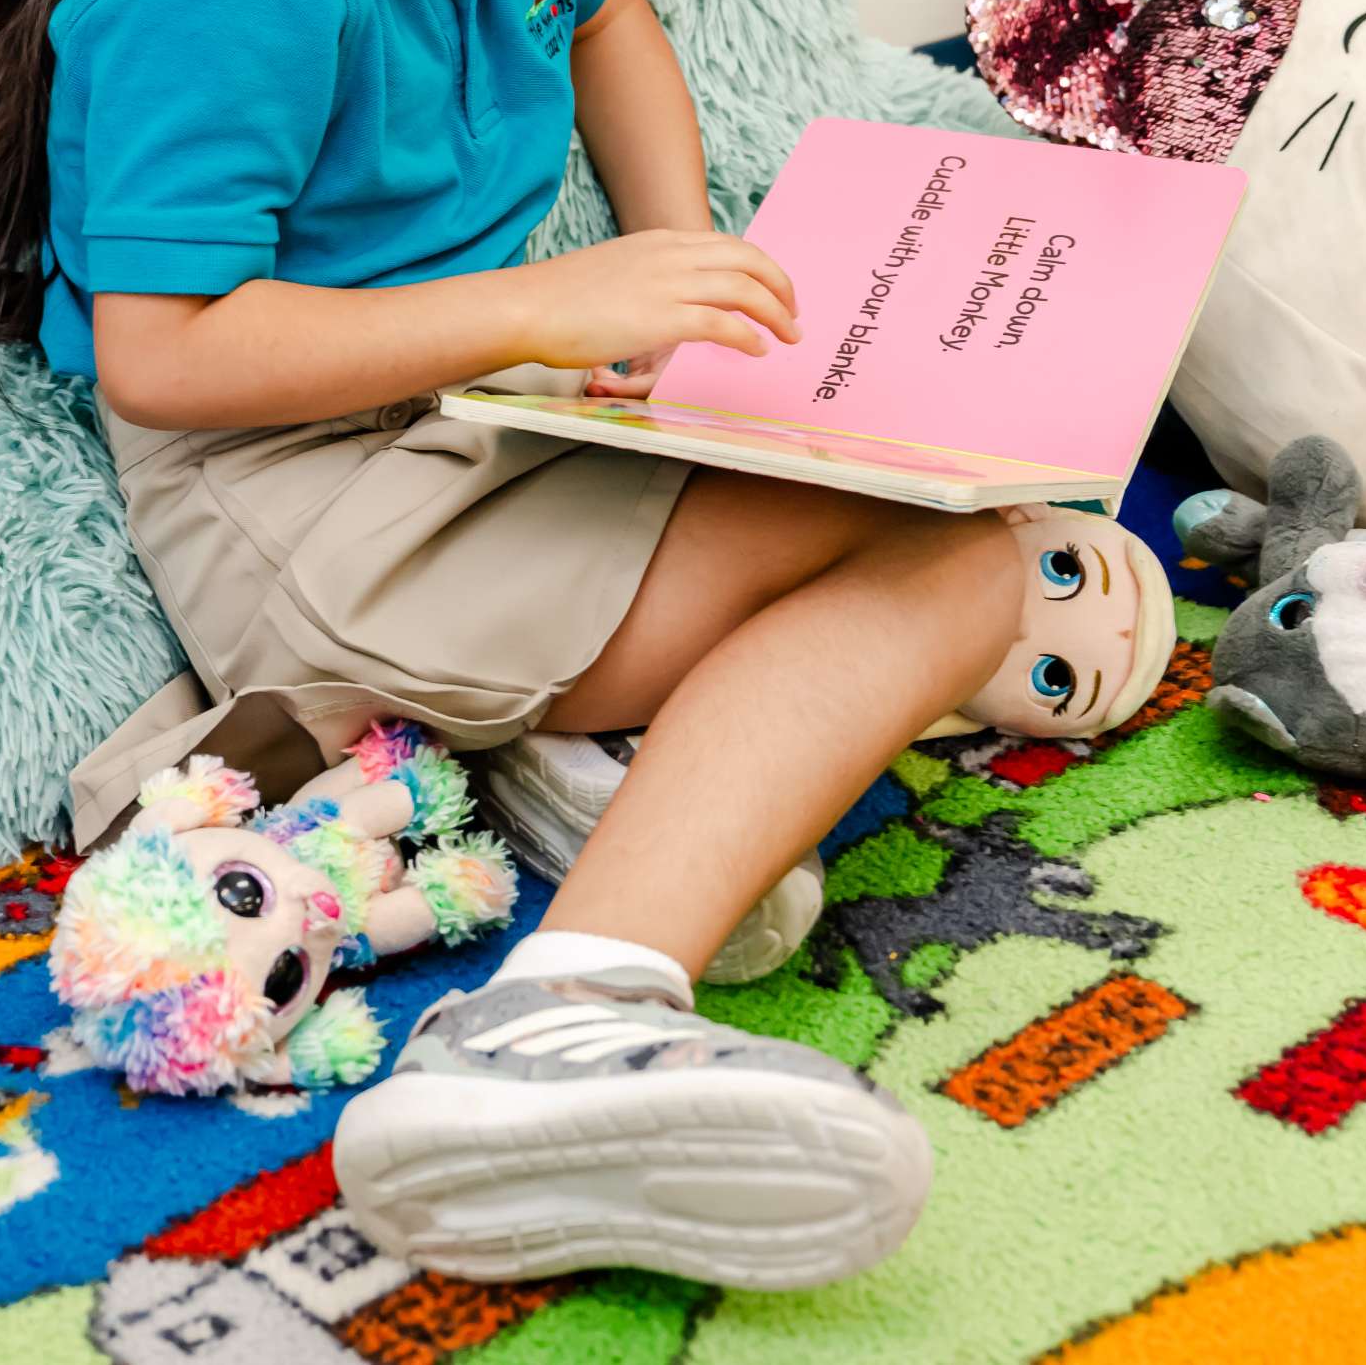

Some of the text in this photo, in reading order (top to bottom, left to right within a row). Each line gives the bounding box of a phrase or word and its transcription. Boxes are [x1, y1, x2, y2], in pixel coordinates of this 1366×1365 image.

[811, 155, 967, 406] Cuddle with your blankie.
[938, 216, 1037, 354] Little Monkey.
[993, 234, 1076, 351] Calm down,
